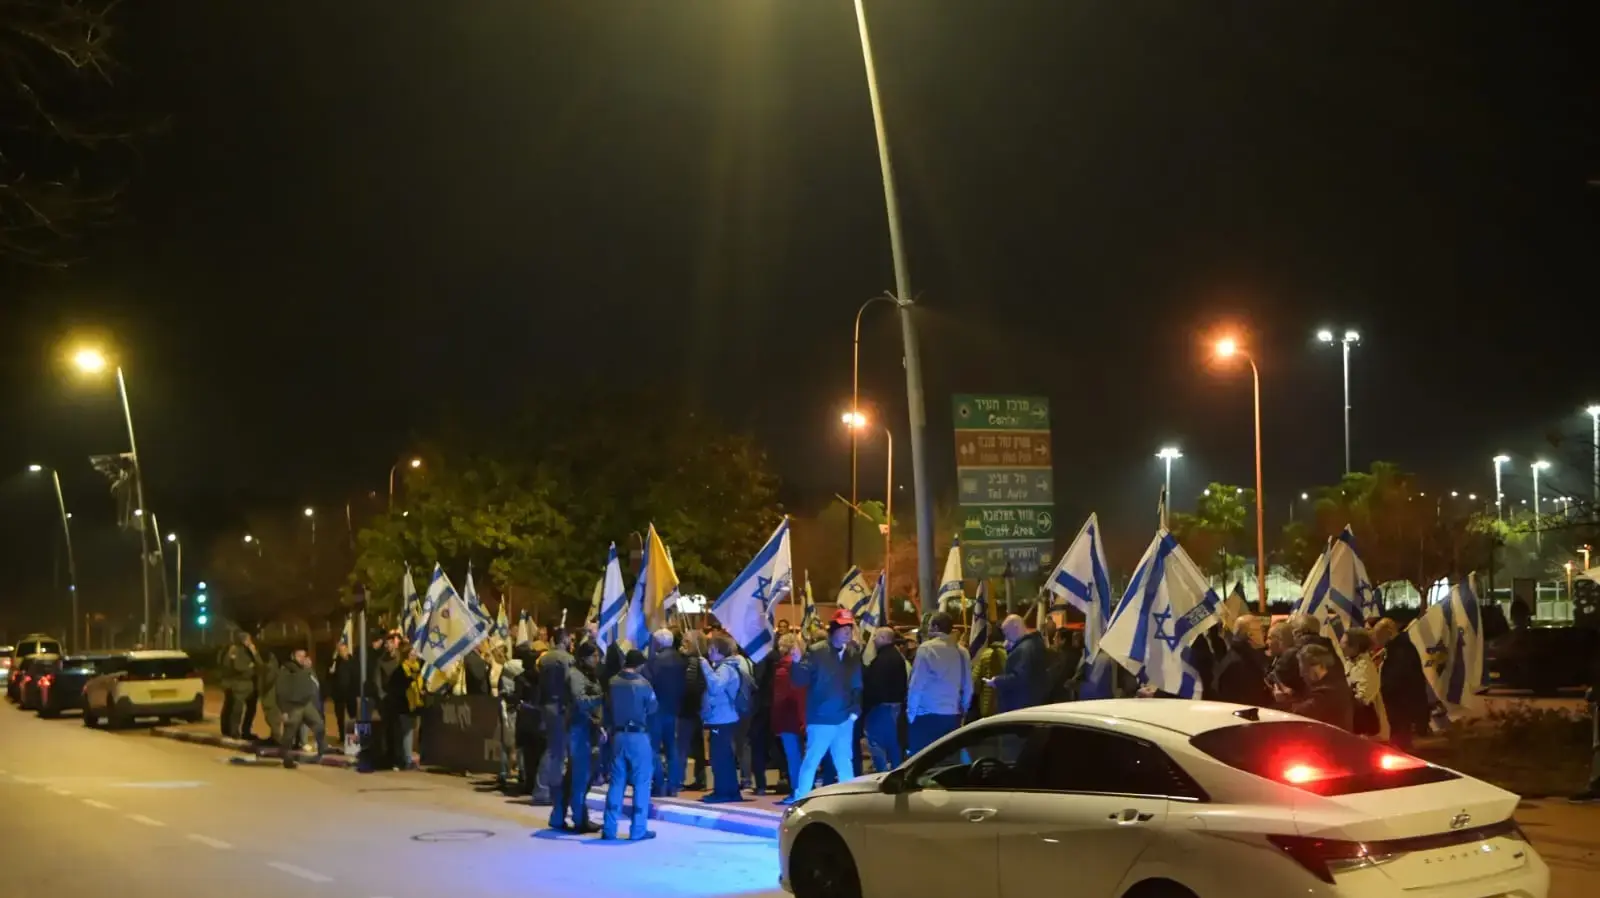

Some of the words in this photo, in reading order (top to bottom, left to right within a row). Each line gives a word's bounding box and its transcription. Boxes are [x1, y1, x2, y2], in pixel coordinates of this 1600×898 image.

[988, 488, 1002, 500] Tel
[1006, 487, 1029, 500] Aviv
[1012, 523, 1036, 537] Area
